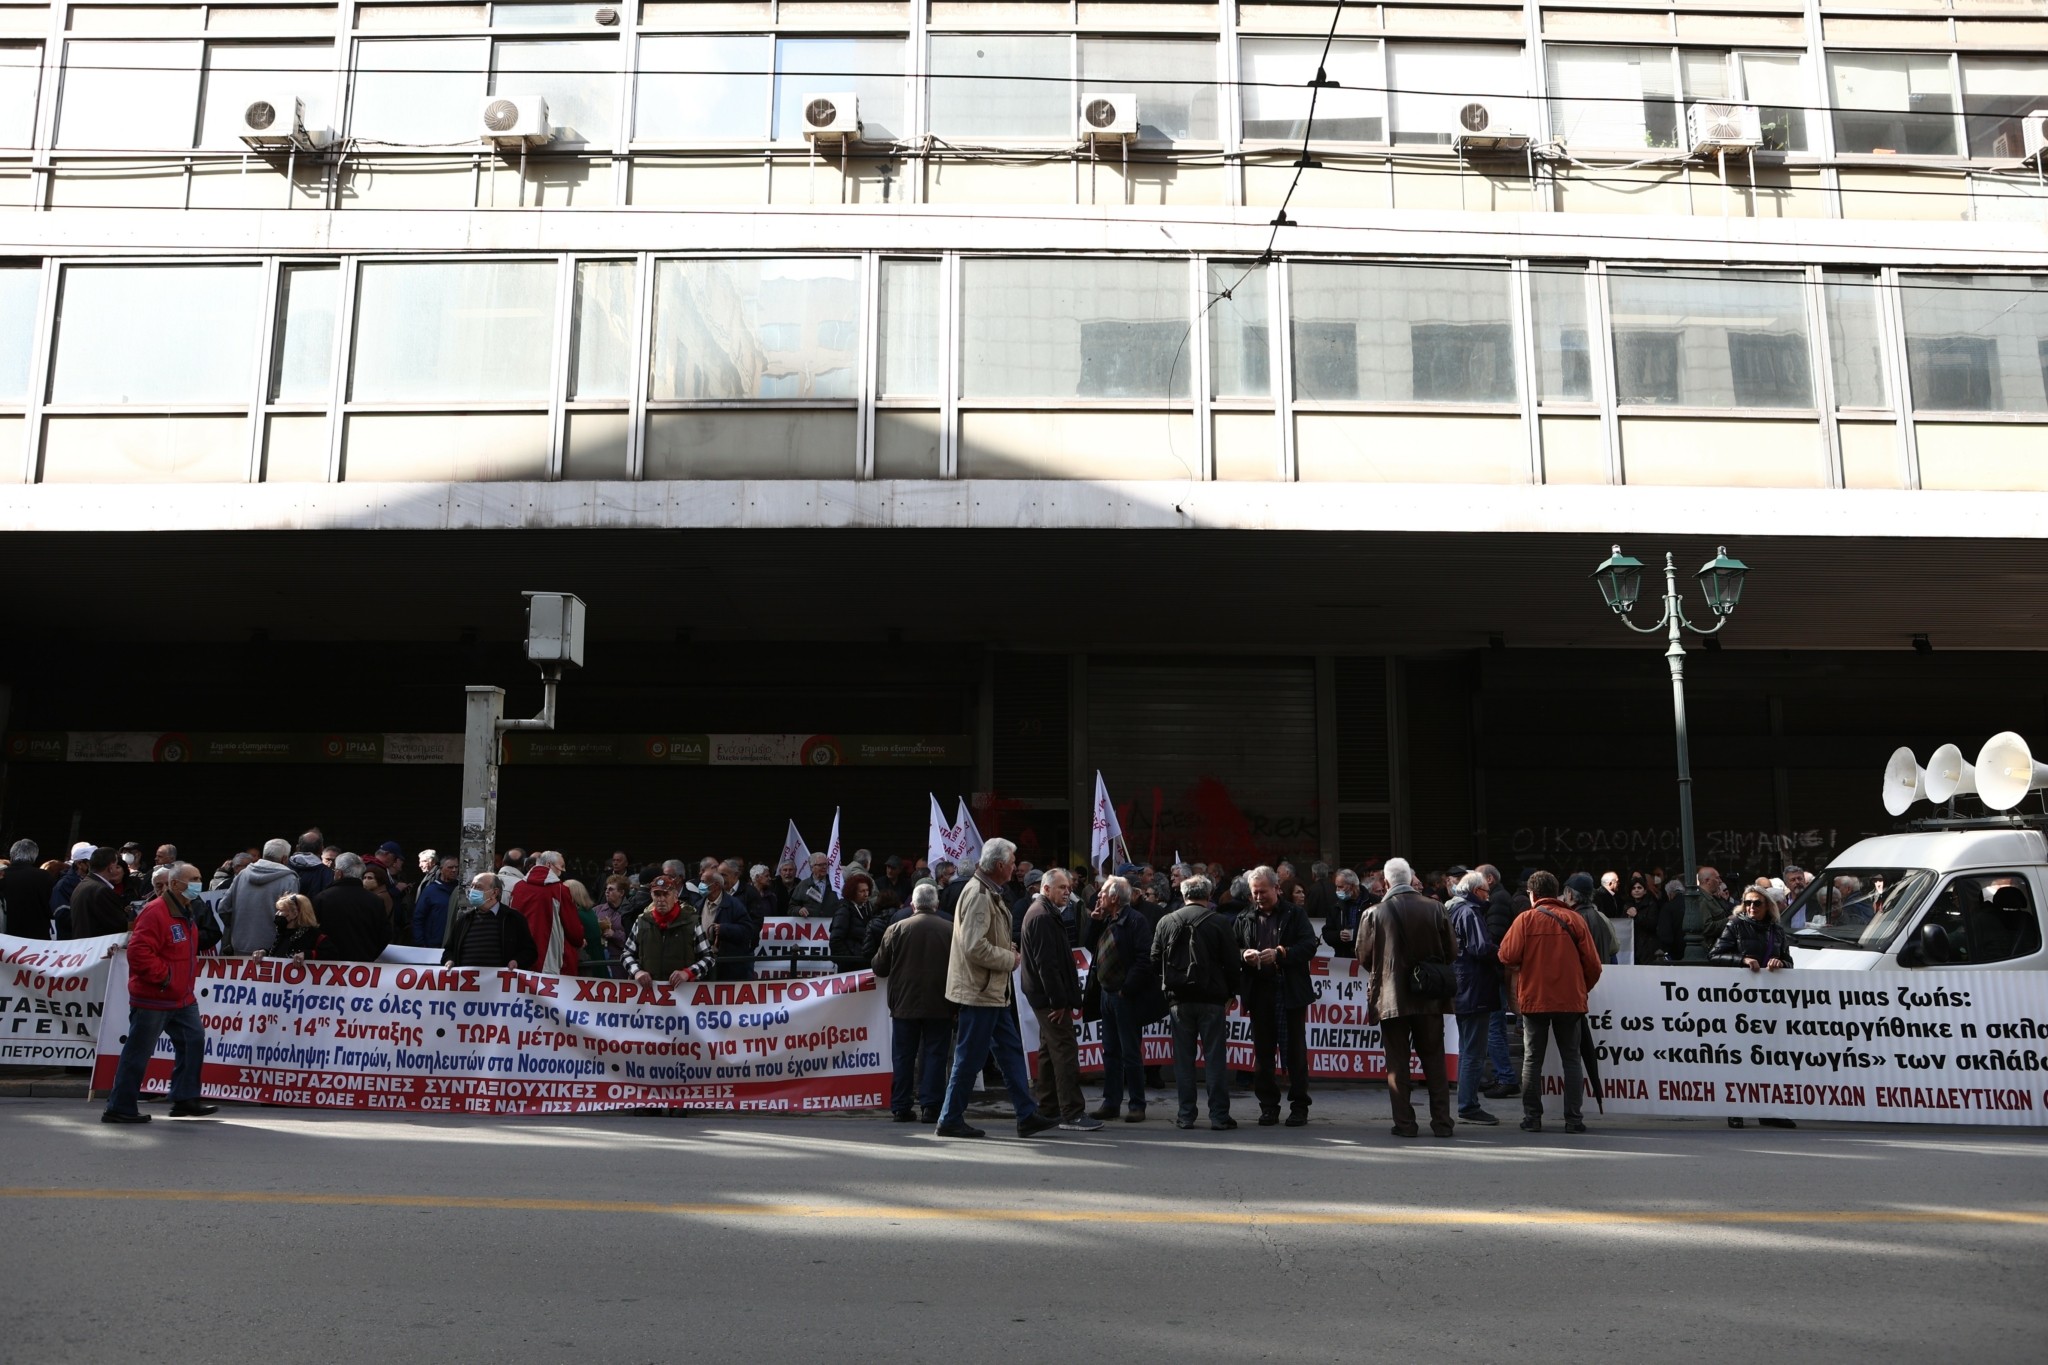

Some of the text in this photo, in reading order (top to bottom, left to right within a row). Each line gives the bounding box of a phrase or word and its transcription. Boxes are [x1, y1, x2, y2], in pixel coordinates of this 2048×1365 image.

[30, 740, 61, 750] ΙΡΙΔΑ
[345, 742, 376, 752] ΙΡΙΔΑ
[670, 743, 702, 753] ΙΡΙΔΑ
[13, 970, 88, 998] Νόμοι
[395, 968, 480, 991] ΟΛΗΣ
[497, 970, 559, 998] ΤΗΣ
[573, 979, 677, 1006] ΧΩΡΑΣ
[691, 972, 877, 1006] ΑΠΑΙΤΟΥΜΕ
[1660, 981, 1972, 1010] Το απόσταγμα μιας ζωής:
[212, 984, 790, 1035] ΤΩΡΑ αυξήσεις σε όλες τις συντάξεις με κατώτερη 650 ευρώ
[0, 1018, 90, 1037] ΓΕΙΑ
[334, 1018, 423, 1046] Σύνταξης
[457, 1024, 511, 1044] ΤΩΡΑ
[517, 1025, 578, 1051] μέτρα
[583, 1037, 701, 1061] προστασίας
[708, 1040, 737, 1061] για
[743, 1036, 778, 1057] την
[784, 1025, 868, 1051] ακρίβεια
[1589, 1010, 1613, 1030] τέ
[1621, 1016, 1654, 1032] ως
[1661, 1012, 1727, 1037] τώρα
[1735, 1013, 1777, 1034] δεν
[1786, 1017, 1953, 1042] καταργήθηκε
[1961, 1022, 1977, 1039] η
[217, 1037, 252, 1062] άμεση
[256, 1041, 329, 1069] πρόσληψη:
[333, 1046, 391, 1071] Γιατρών,
[396, 1050, 485, 1074] Νοσηλευτών
[488, 1056, 513, 1072] στα
[518, 1053, 605, 1079] Νοσοκομεία
[625, 1048, 881, 1083] Να ανοίξουν αυτά που έχουν κλείσει
[1313, 1053, 1348, 1071] ΔΕΚΟ
[1353, 1055, 1363, 1073] &
[1597, 1040, 1644, 1065] όγω
[1653, 1043, 1742, 1065] «καλής
[1750, 1045, 1886, 1071] διαγωγής»
[1894, 1053, 1946, 1069] των
[201, 1082, 263, 1100] ΗΜΟΣΙΟΥ
[273, 1088, 311, 1104] ΠΟΣΕ
[315, 1091, 355, 1106] ΟΑΕΕ
[368, 1094, 407, 1109] ΕΛΤΑ
[420, 1096, 451, 1110] ΟΣΕ
[465, 1098, 491, 1112] ΠΕΣ
[495, 1099, 528, 1113] ΝΑΤ
[541, 1100, 572, 1113] ΠΣΣ
[739, 1098, 789, 1111] ΕΤΕΑΠ
[803, 1093, 883, 1110] ΕΣΤΑΜΕΔΕ
[239, 1068, 735, 1100] ΣΥΝΕΡΓΑΖΟΜΕΝΕΣ ΣΥΝΤΑΞΙΟΥΧΙΚΕΣ ΟΡΓΑΝΩΣΕΙΣ
[1659, 1080, 1715, 1102] ΕΝΩΣΗ
[1725, 1082, 1866, 1106] ΣΥΝΤΑΞΙΟΥΧΩΝ
[1876, 1087, 2033, 1111] ΕΚΠΑΙΔΕΥΤΙΚΩΝ
